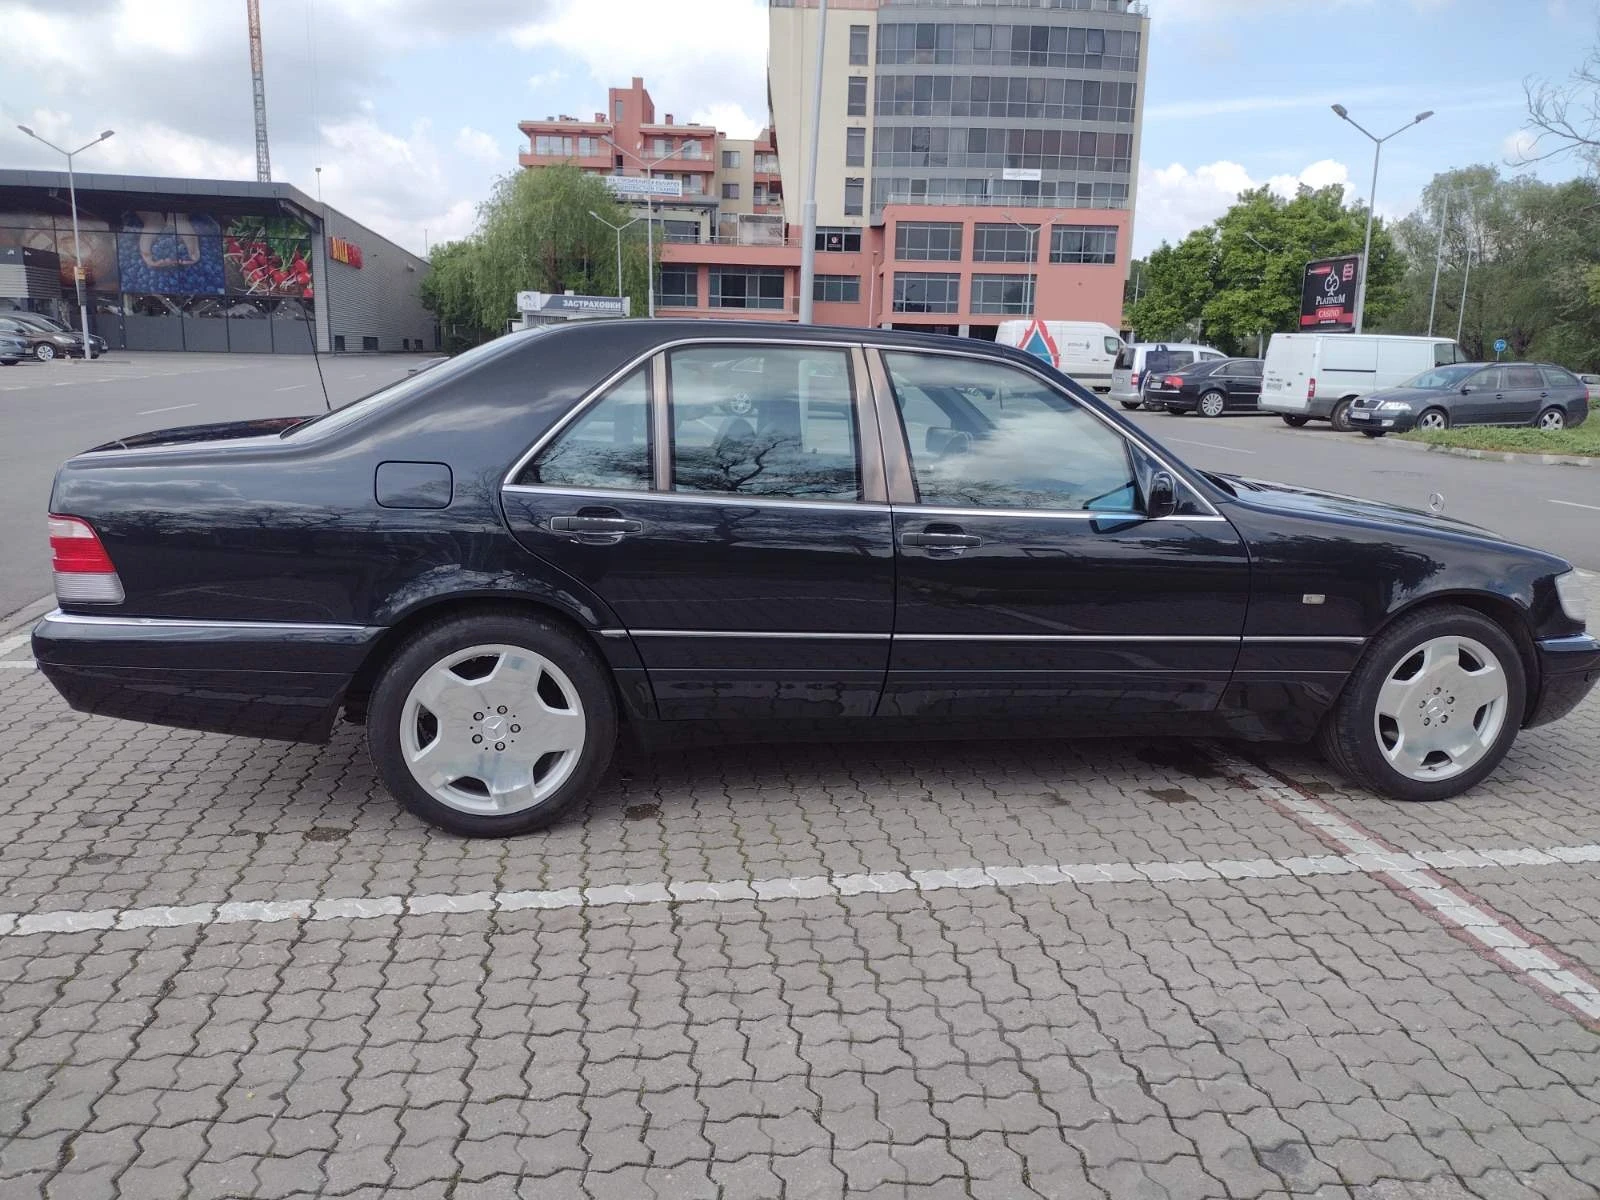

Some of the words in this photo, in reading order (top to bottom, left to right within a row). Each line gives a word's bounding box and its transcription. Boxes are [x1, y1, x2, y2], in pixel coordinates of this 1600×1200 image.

[562, 299, 622, 309] ЗАСТРАХОВКИ
[1315, 293, 1346, 306] PLATINUM
[1318, 309, 1340, 318] CASINO
